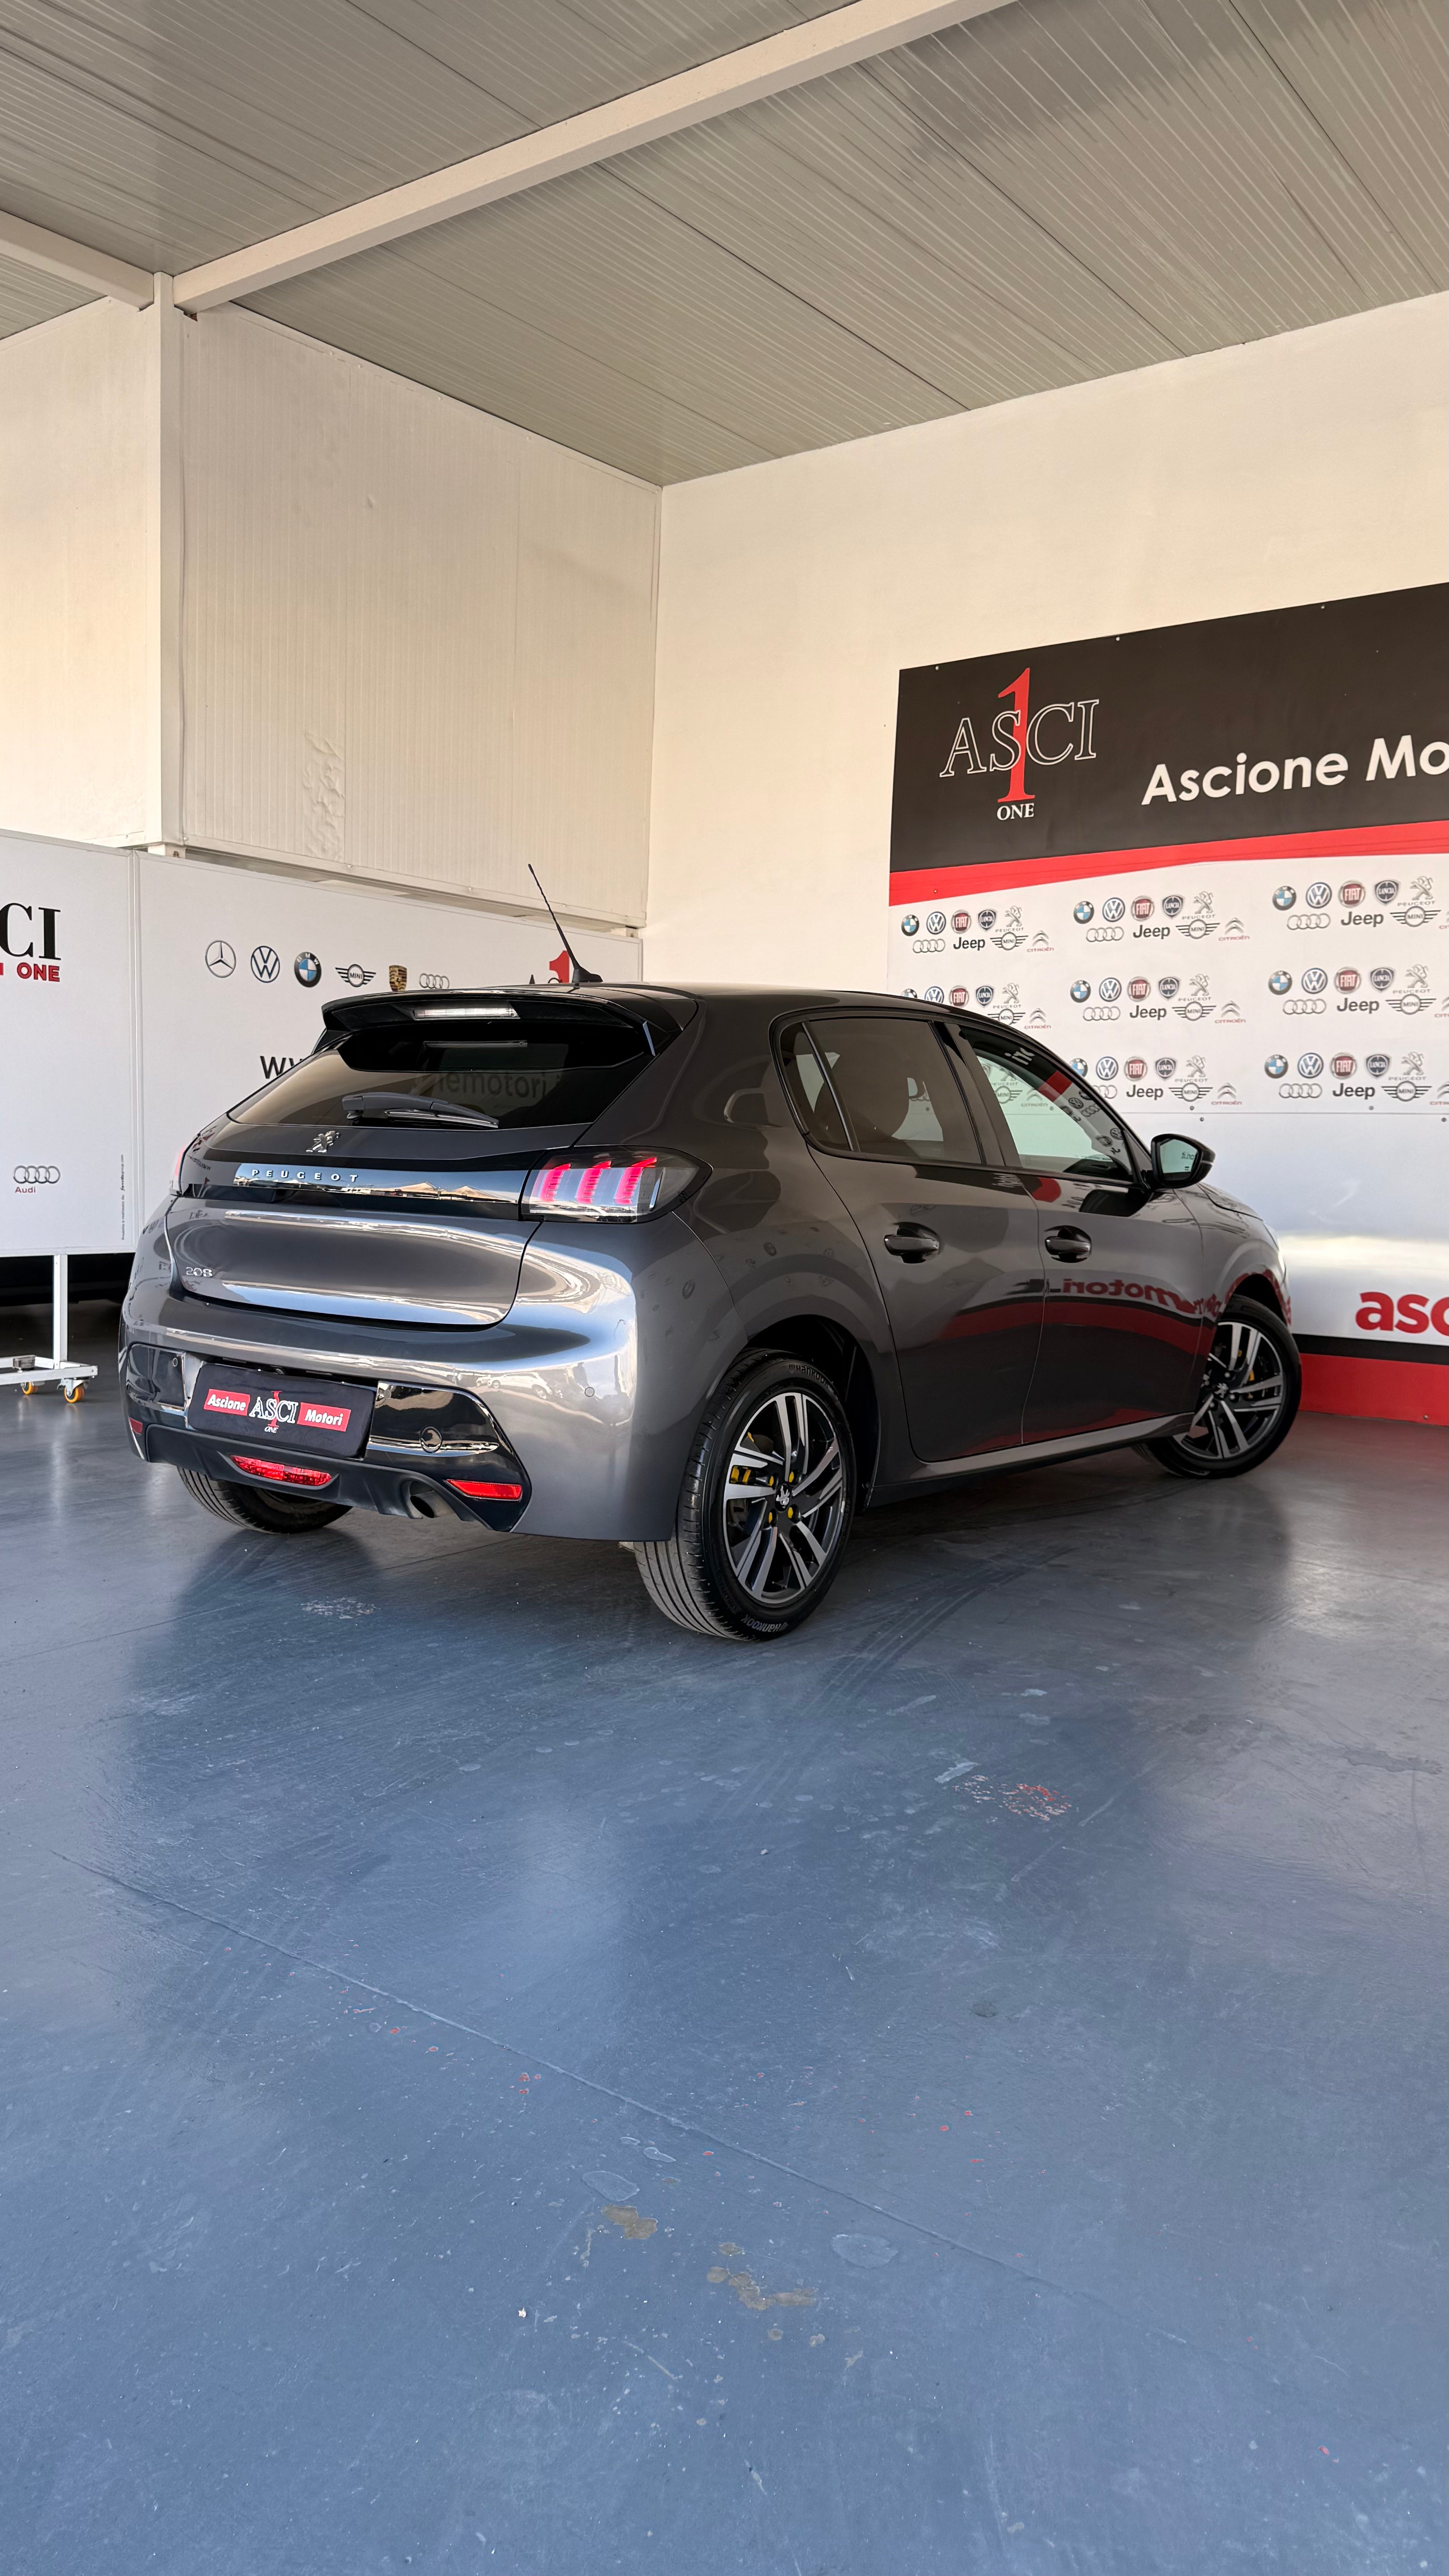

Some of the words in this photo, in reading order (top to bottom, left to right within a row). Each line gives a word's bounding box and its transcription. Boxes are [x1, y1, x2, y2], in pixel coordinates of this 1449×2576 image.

[939, 699, 1099, 777] ASCI
[1141, 752, 1348, 805] Ascione
[997, 803, 1035, 820] ONE
[1344, 888, 1361, 901] FIAT
[1136, 902, 1150, 915] FIAT
[956, 916, 967, 928] FIAT
[1341, 911, 1384, 927] Jeep
[1133, 925, 1170, 939] Jeep
[953, 937, 985, 951] Jeep
[17, 962, 60, 982] ONE
[1340, 975, 1356, 987] FIAT
[1133, 984, 1146, 995] FIAT
[953, 992, 965, 1003] FIAT
[1130, 1005, 1167, 1020] Jeep
[1337, 998, 1380, 1014] Jeep
[1129, 1063, 1143, 1075] FIAT
[1336, 1060, 1352, 1072] FIAT
[1126, 1085, 1164, 1100] Jeep
[1332, 1083, 1375, 1100] Jeep
[251, 1169, 358, 1182] PEUGEOT
[186, 1267, 213, 1278] 208
[207, 1394, 246, 1411] Ascione
[249, 1397, 299, 1424] ASCI
[305, 1409, 343, 1426] Motori
